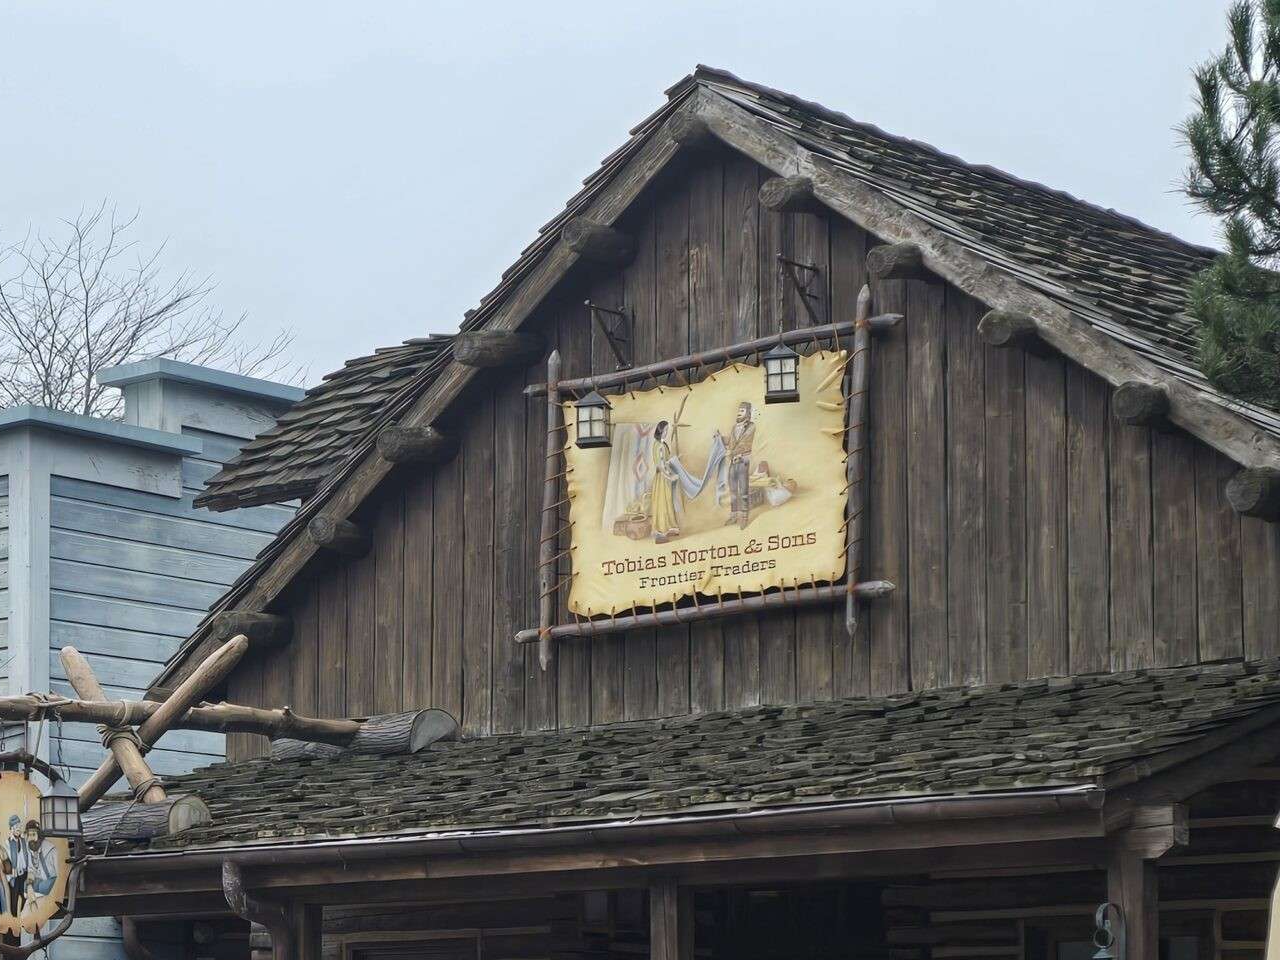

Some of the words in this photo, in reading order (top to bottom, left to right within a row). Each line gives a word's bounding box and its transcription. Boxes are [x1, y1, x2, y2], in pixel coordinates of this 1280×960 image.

[601, 555, 667, 577] Tobias
[671, 544, 742, 567] Norton
[744, 538, 763, 555] &
[767, 531, 818, 552] Sons
[639, 570, 706, 588] Frontier
[710, 558, 777, 578] Traders
